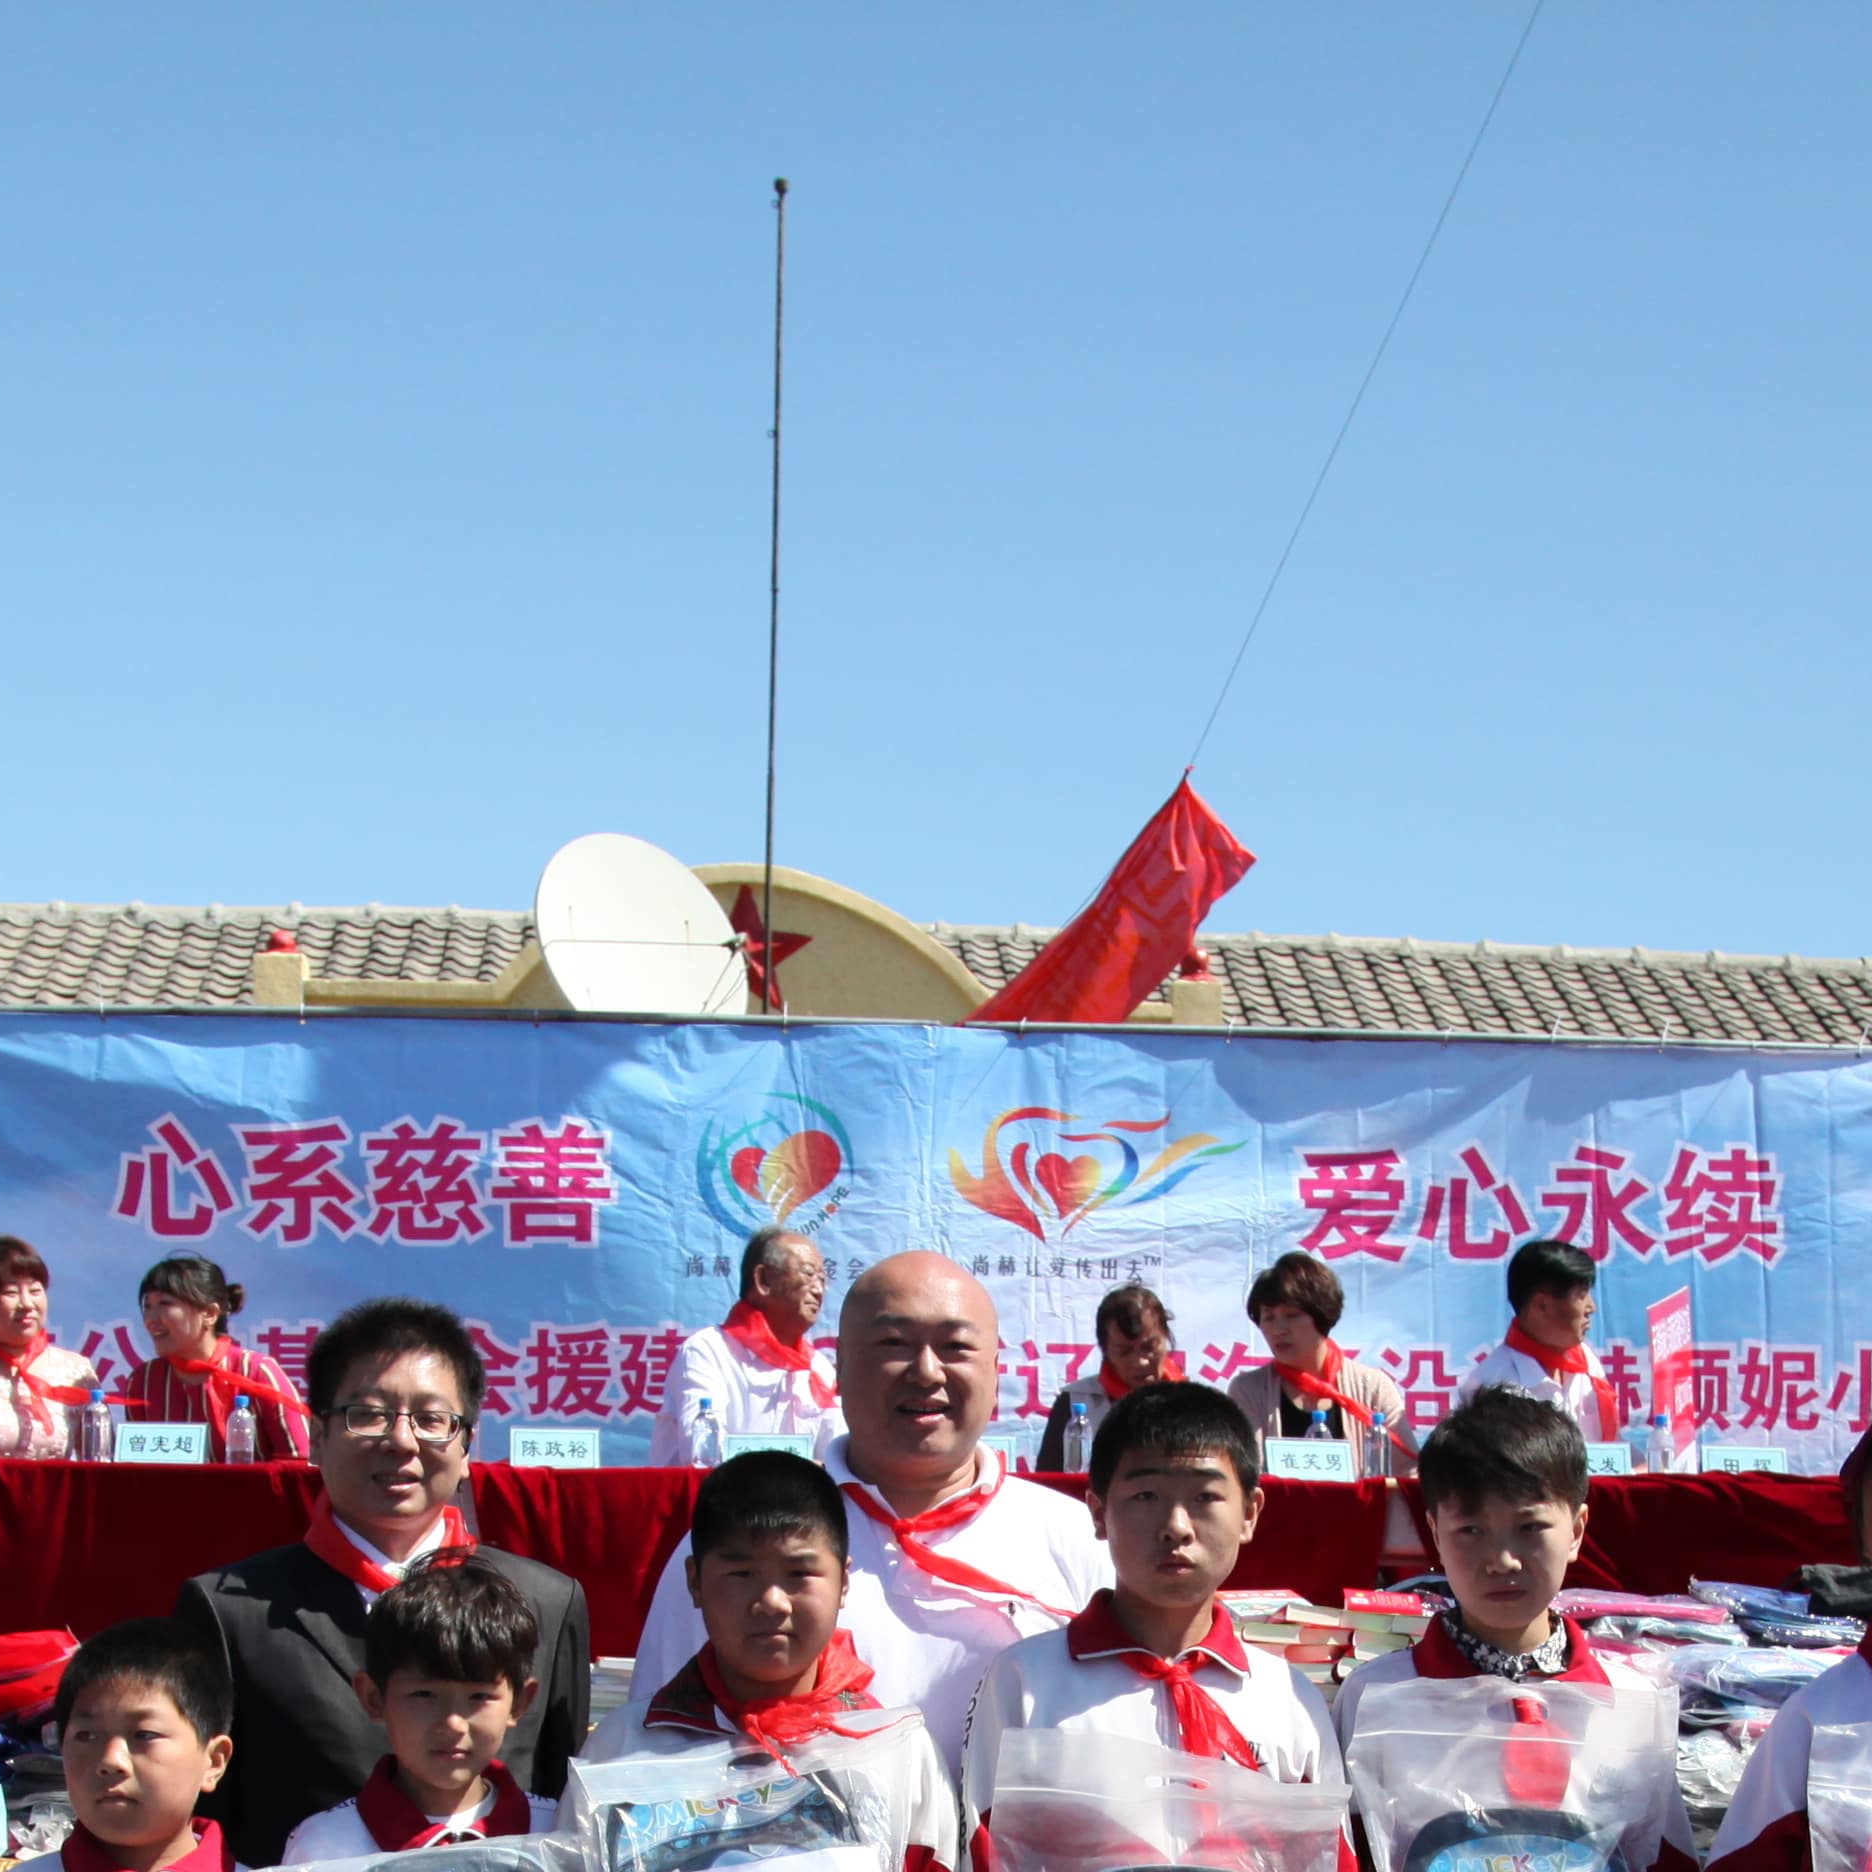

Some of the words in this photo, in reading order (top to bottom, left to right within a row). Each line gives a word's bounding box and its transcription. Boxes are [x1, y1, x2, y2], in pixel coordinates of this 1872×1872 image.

[120, 1117, 612, 1244] 心系慈善
[1298, 1146, 1783, 1264] 爱心永续
[521, 1438, 590, 1460] 陈政裕
